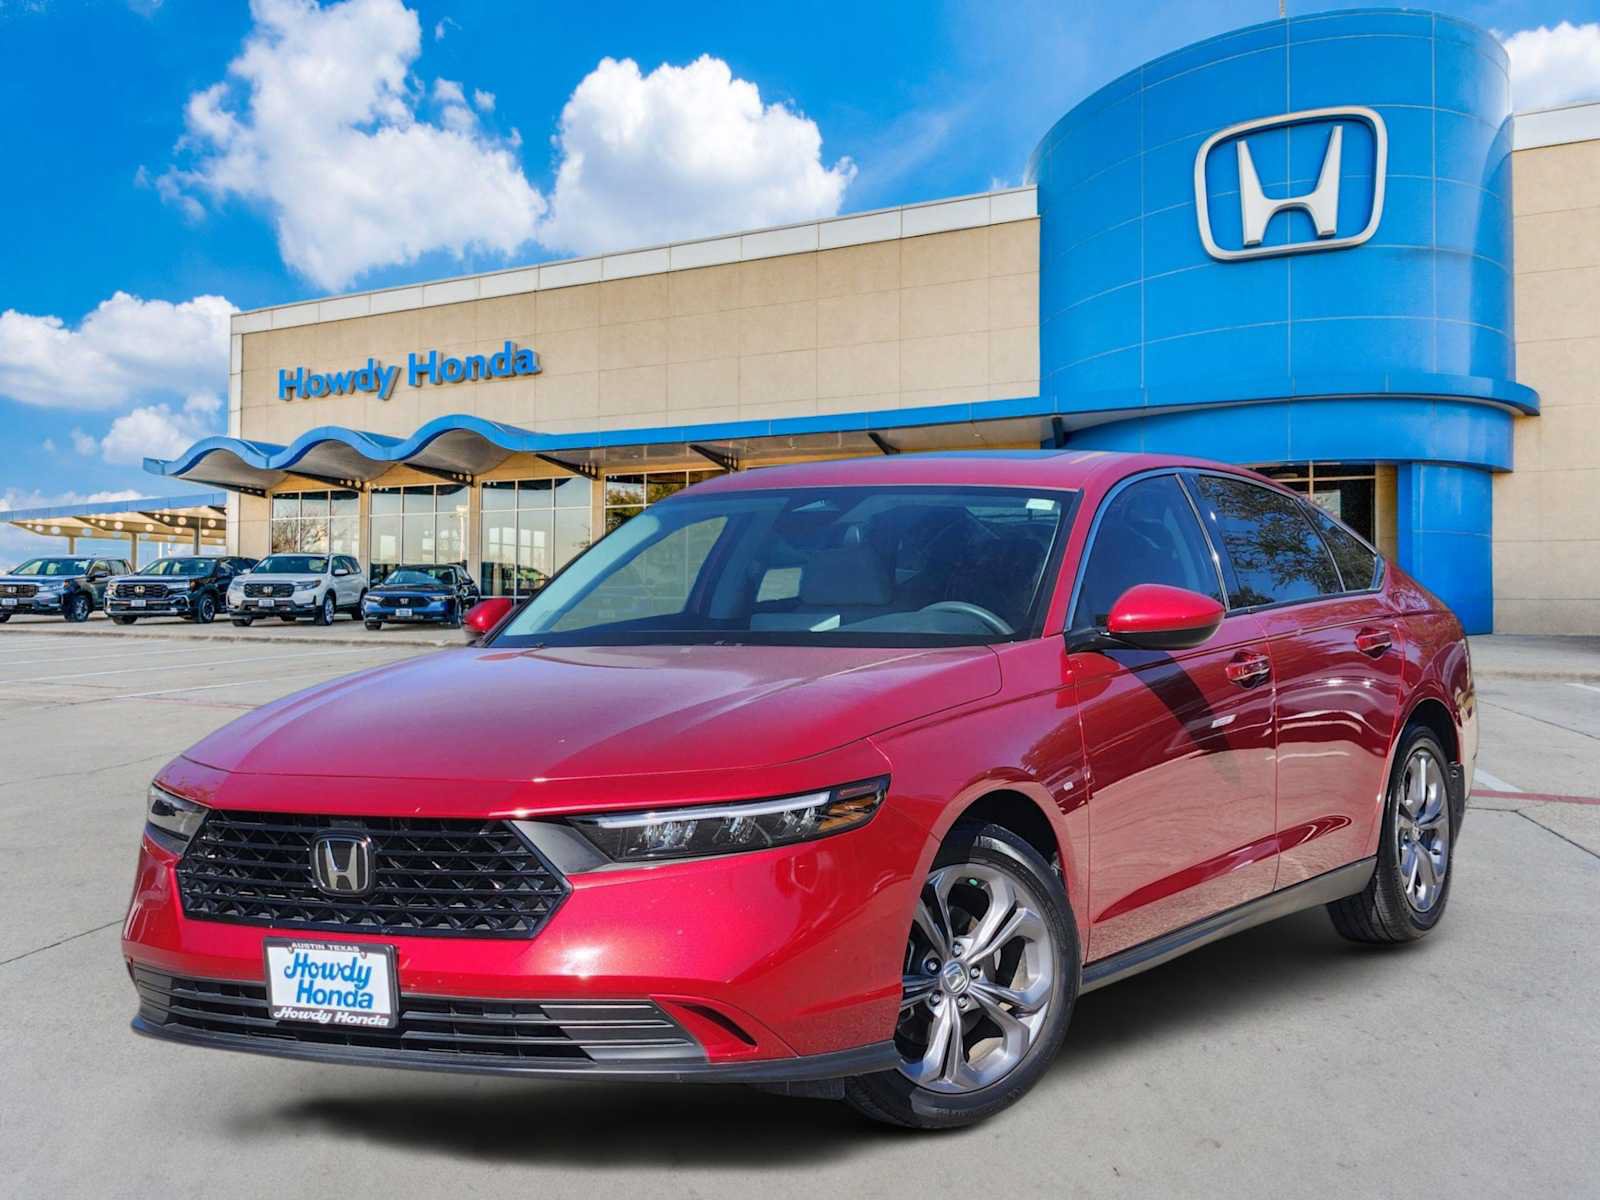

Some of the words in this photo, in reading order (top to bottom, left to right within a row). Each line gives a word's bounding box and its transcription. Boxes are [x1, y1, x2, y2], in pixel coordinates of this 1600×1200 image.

[278, 357, 401, 401] Howdy
[408, 340, 541, 388] Honda
[284, 952, 372, 990] Howdy
[296, 978, 374, 1009] Honda
[274, 1007, 331, 1024] Howdy
[334, 1012, 389, 1026] Honda
